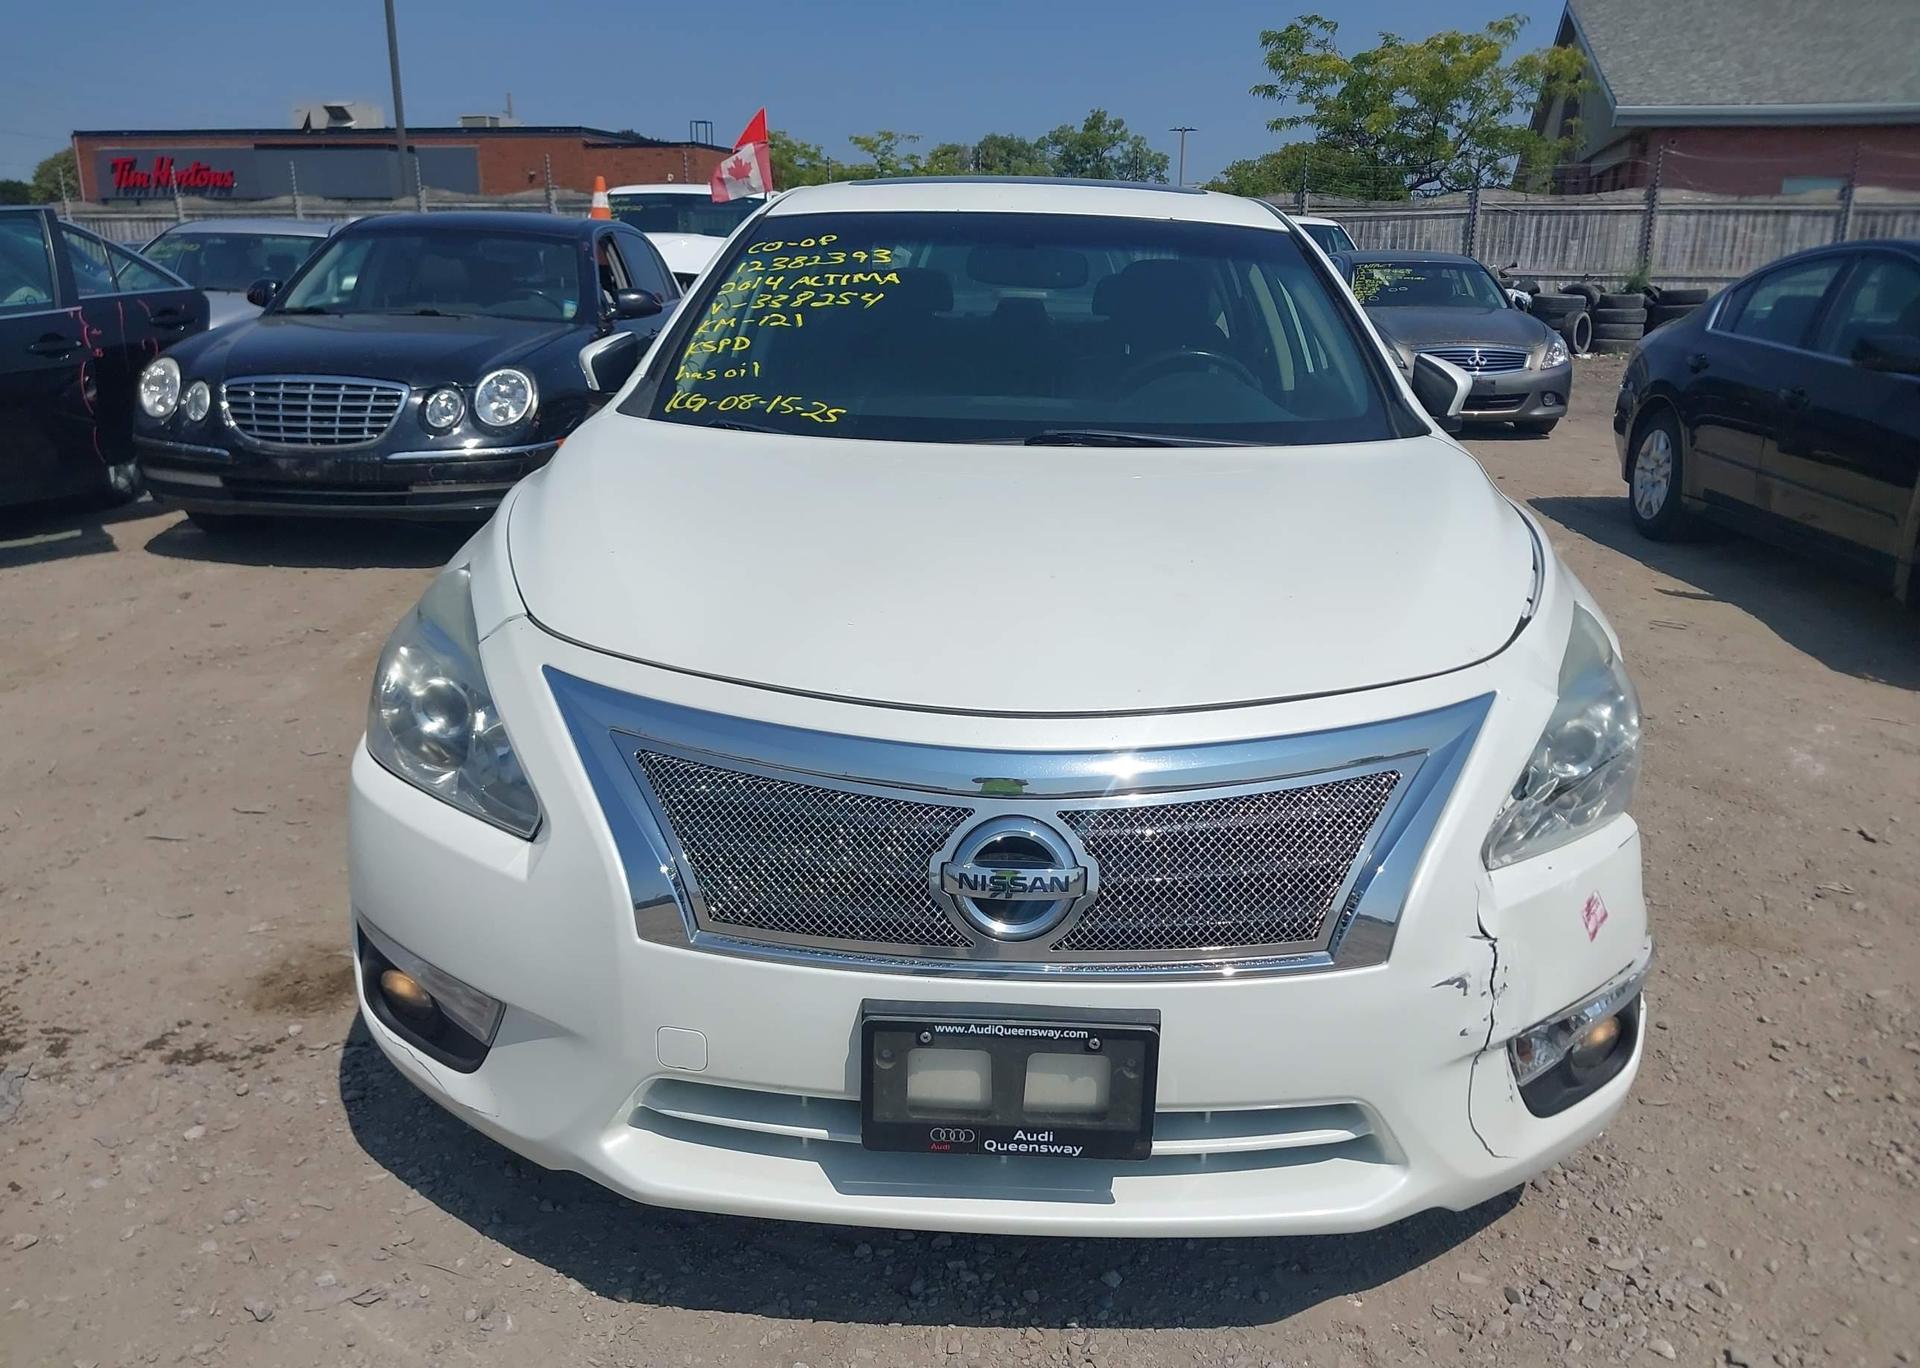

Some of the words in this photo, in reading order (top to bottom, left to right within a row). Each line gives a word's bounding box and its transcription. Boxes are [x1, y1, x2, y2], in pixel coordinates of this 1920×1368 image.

[110, 157, 151, 188] Tim
[717, 276, 784, 296] 2014
[724, 362, 760, 377] oil
[958, 872, 1070, 893] NISSAN
[934, 1024, 1088, 1040] www.AudiQueensway.com
[1013, 1129, 1054, 1142] Audi
[930, 1143, 951, 1151] Audi
[984, 1139, 1083, 1157] Queensway
